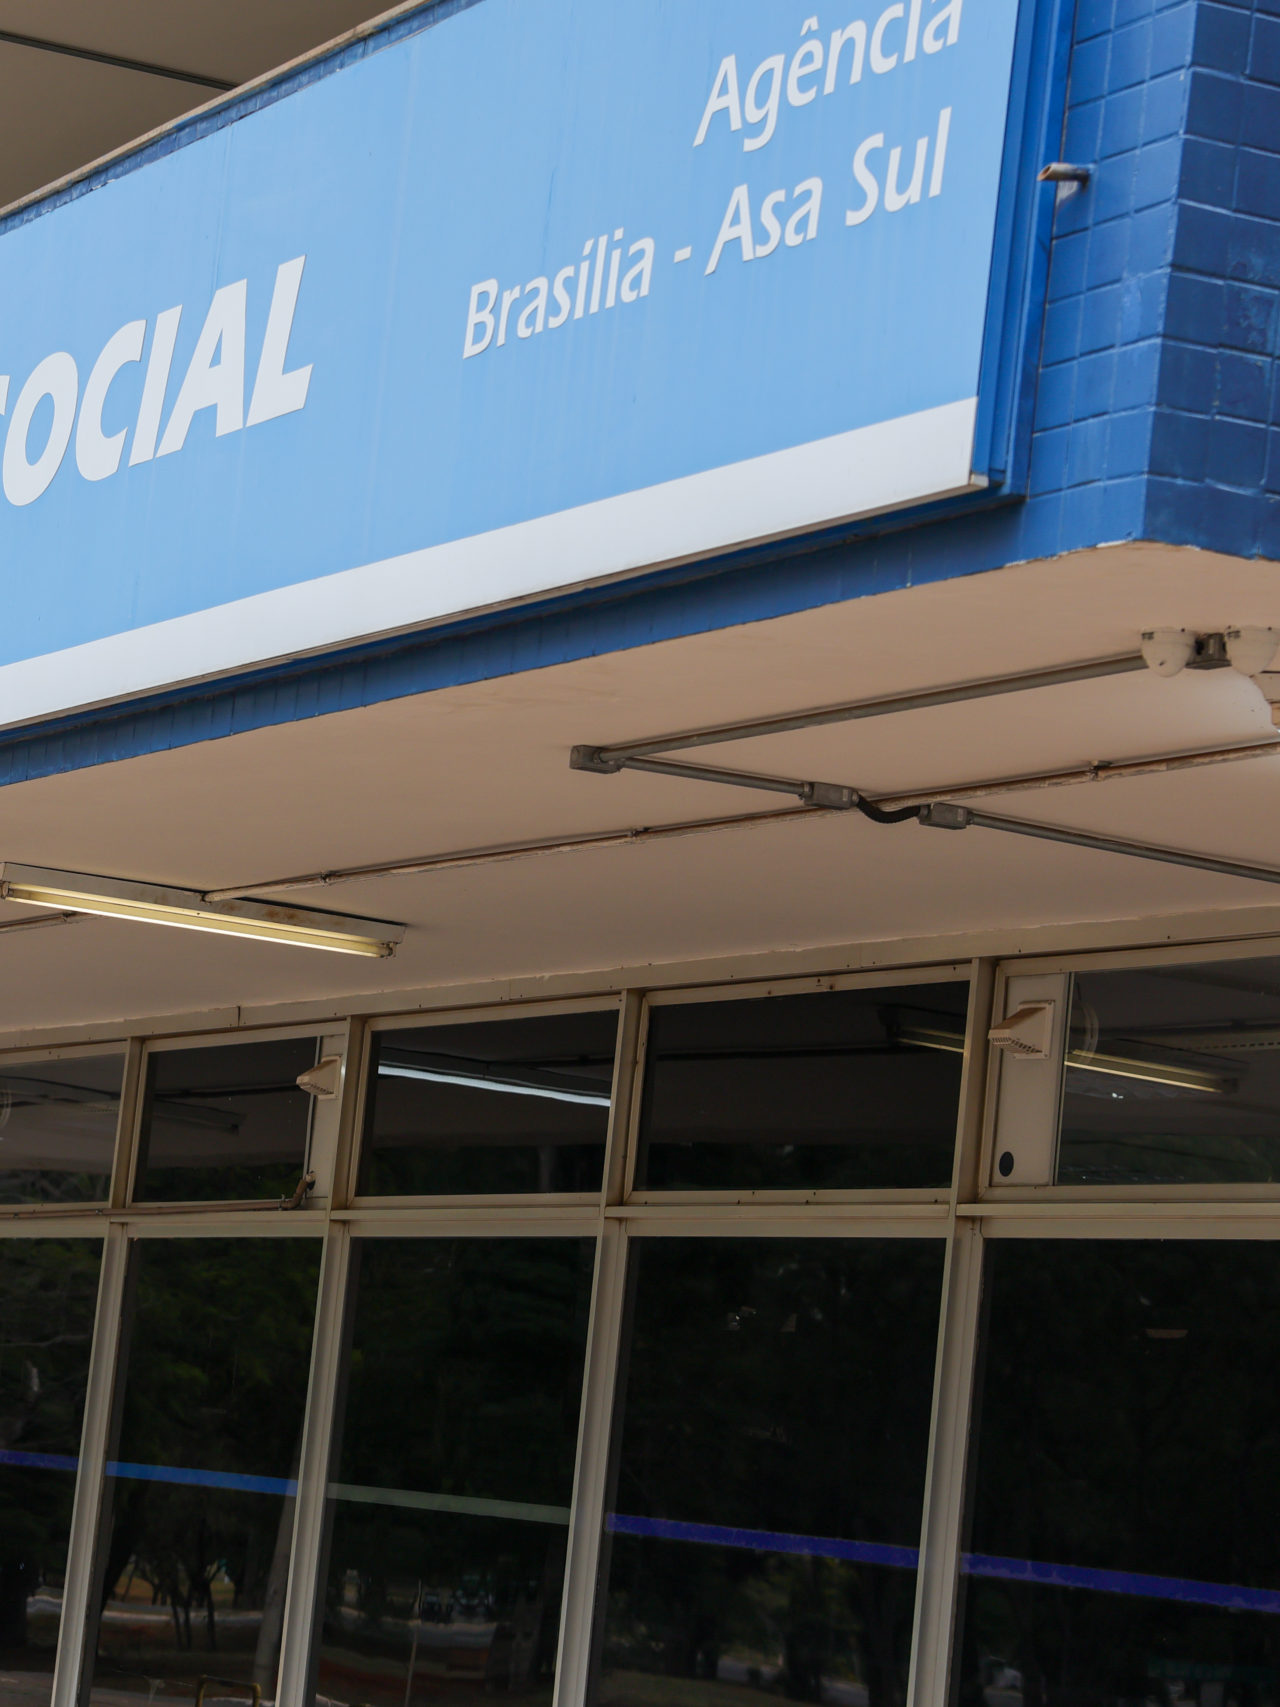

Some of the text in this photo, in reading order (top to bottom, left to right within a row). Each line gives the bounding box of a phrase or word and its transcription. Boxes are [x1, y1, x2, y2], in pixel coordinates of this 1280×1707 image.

[691, 0, 964, 153] Agência
[462, 234, 656, 360] Brasília
[704, 175, 824, 276] Asa
[845, 106, 954, 227] Sul
